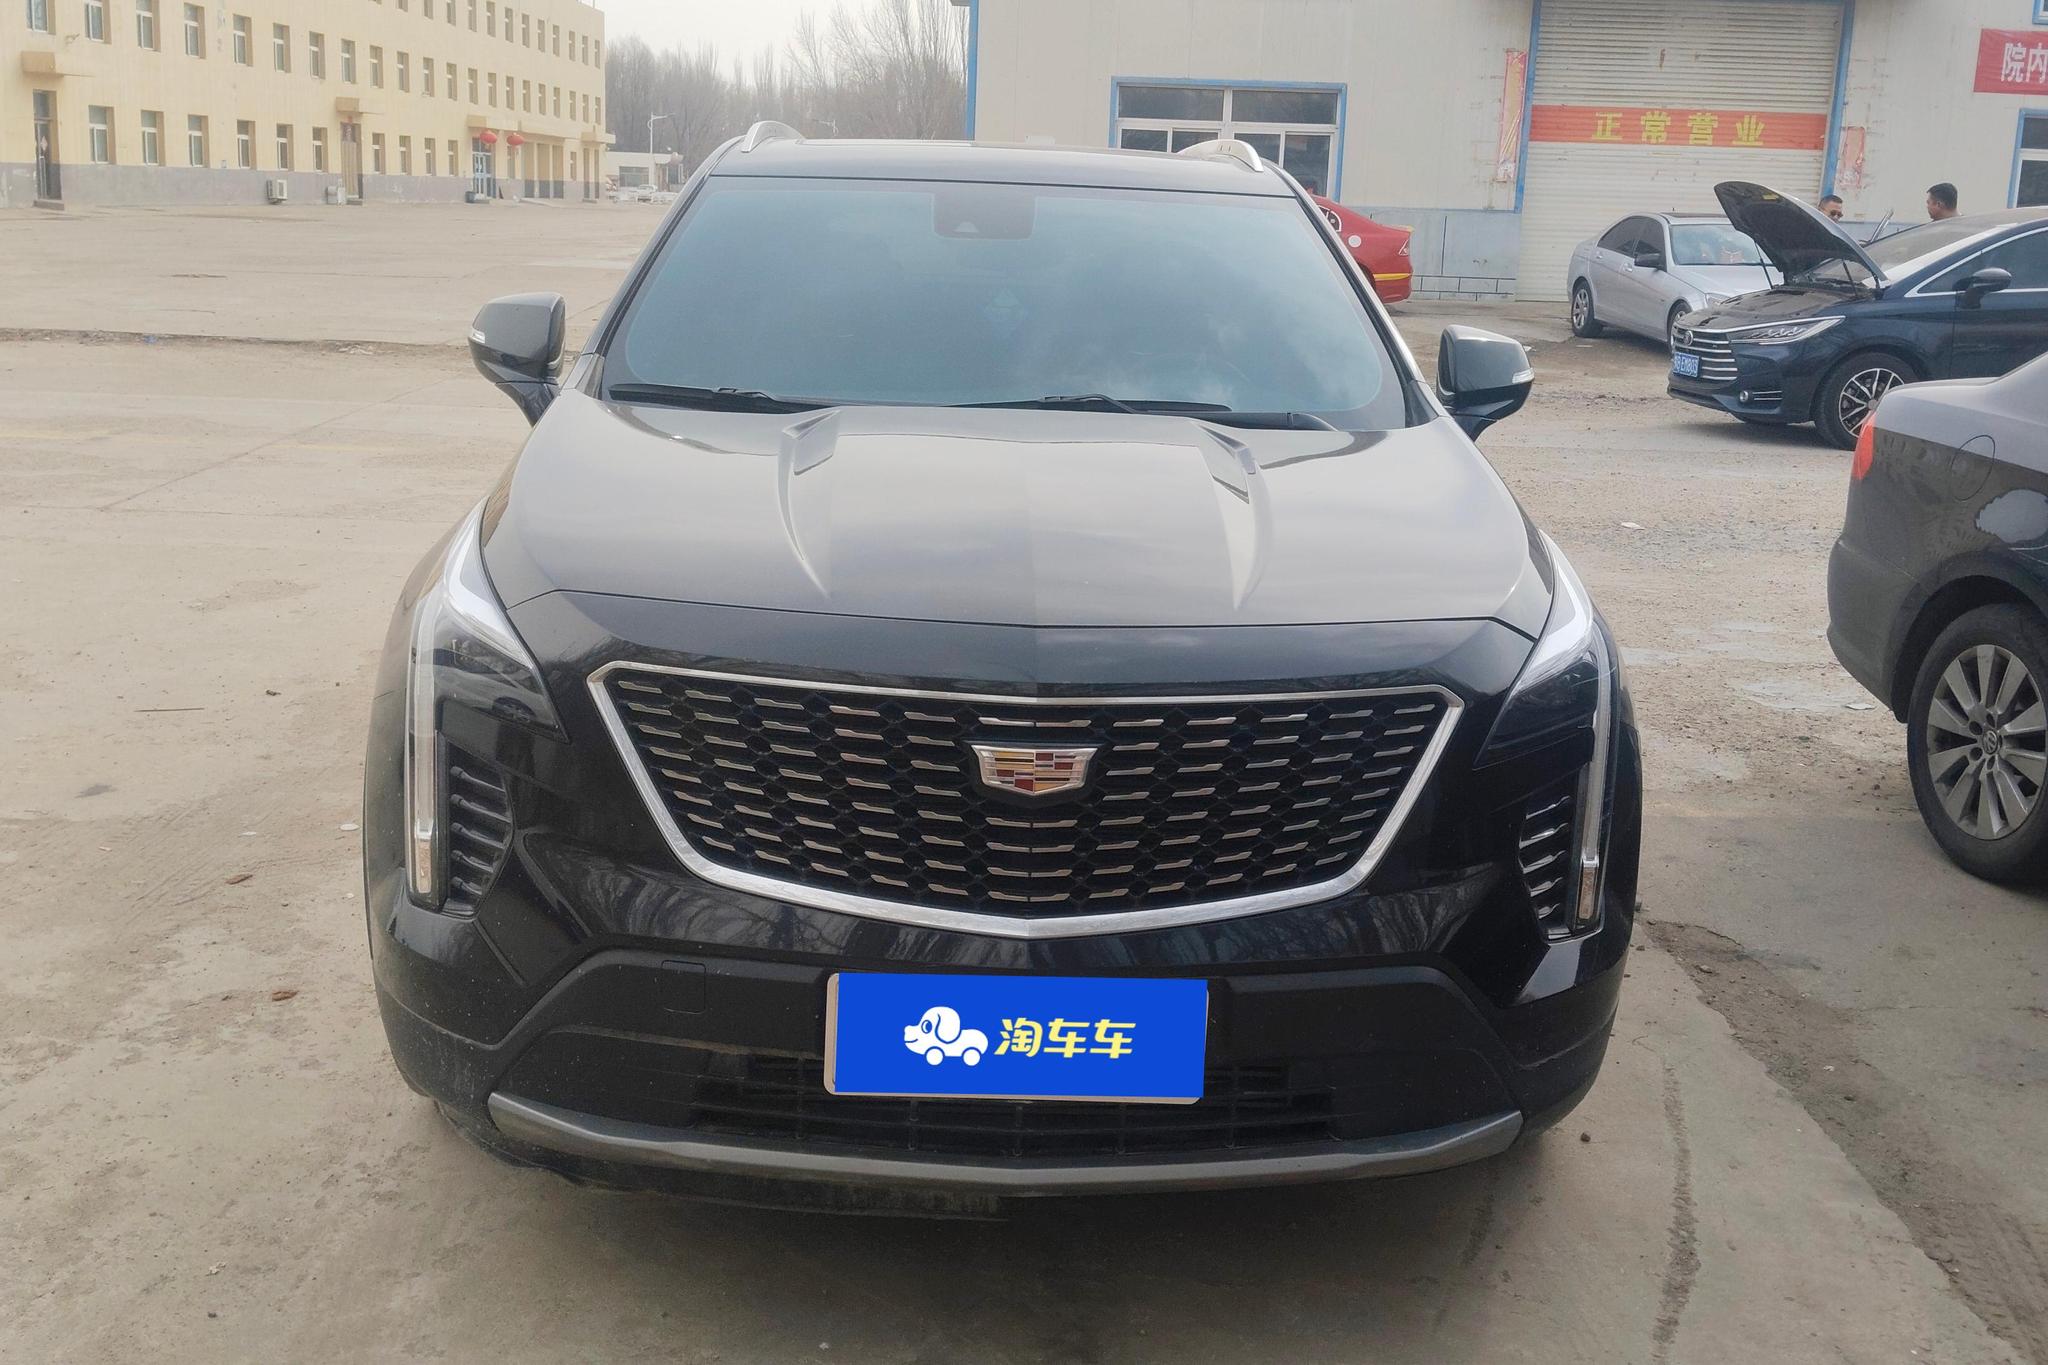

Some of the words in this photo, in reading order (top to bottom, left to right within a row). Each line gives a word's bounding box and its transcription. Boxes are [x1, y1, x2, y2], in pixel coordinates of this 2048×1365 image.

[2000, 42, 2048, 83] 院内
[1592, 111, 1765, 146] 正常营业
